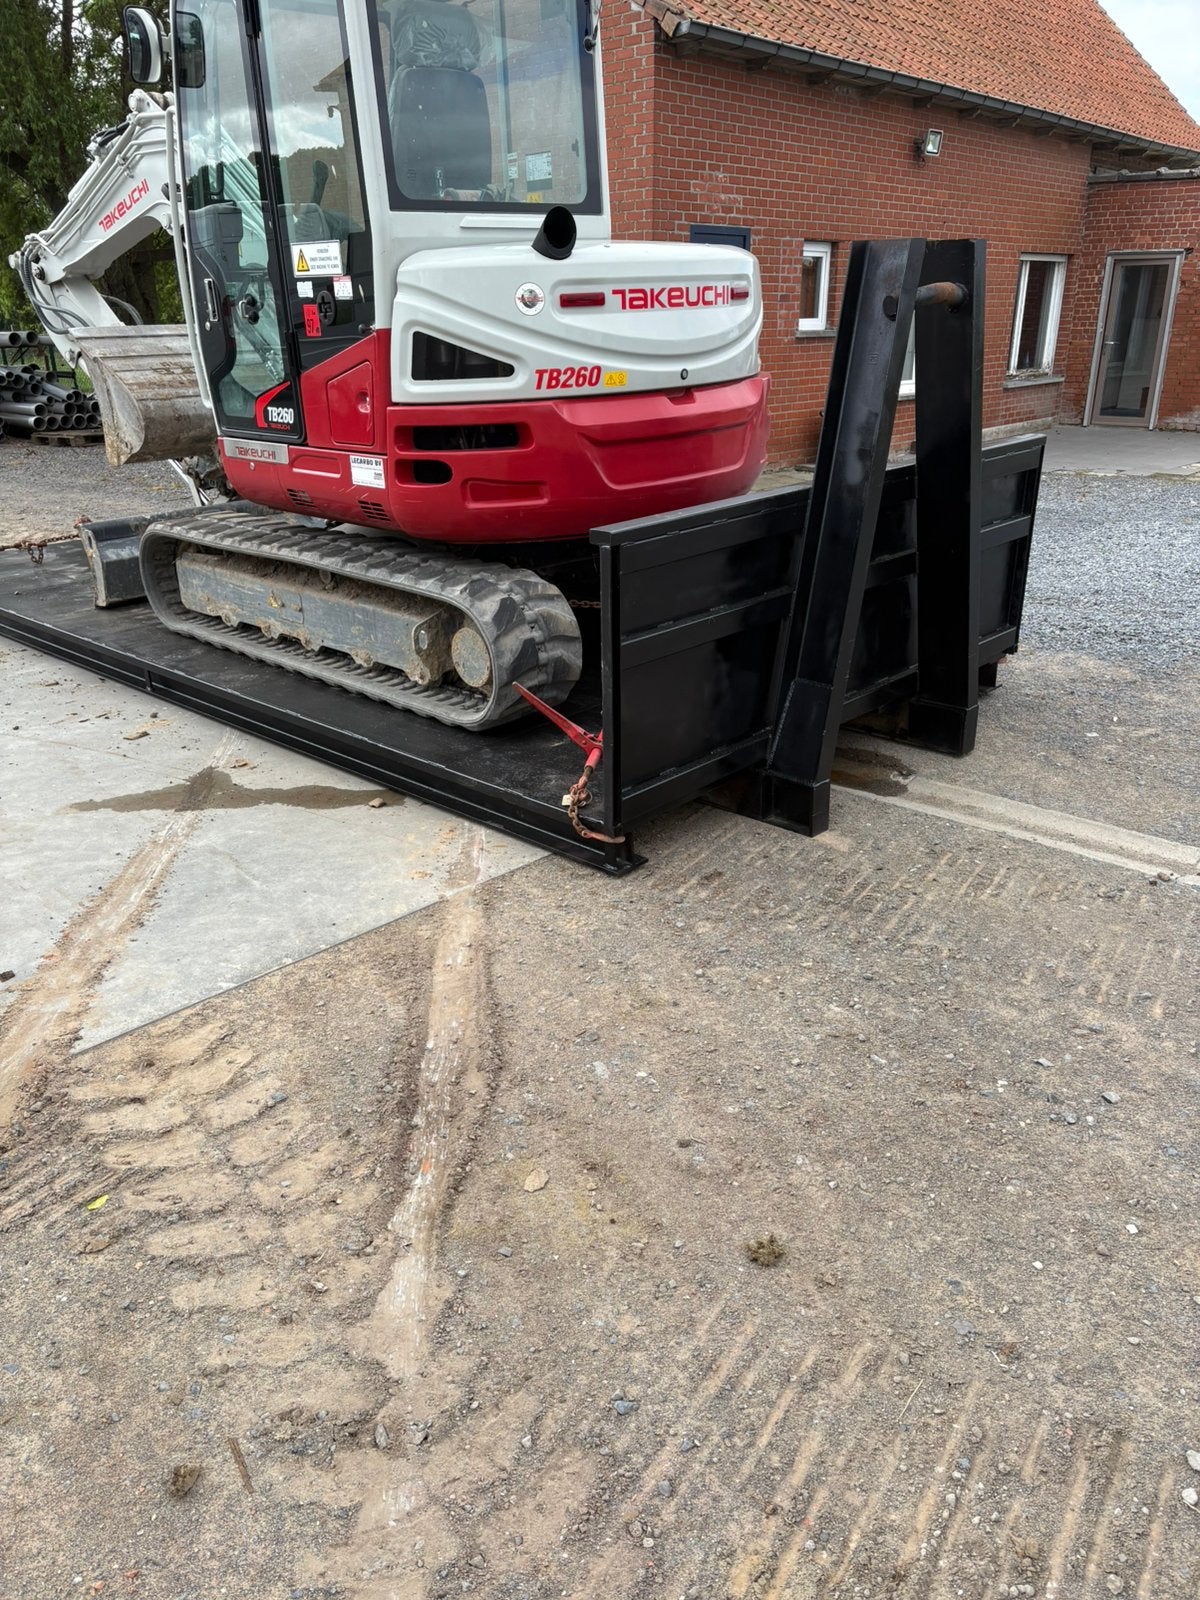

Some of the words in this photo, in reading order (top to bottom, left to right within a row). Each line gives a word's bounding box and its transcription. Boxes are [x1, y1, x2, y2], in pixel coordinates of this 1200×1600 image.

[98, 178, 150, 232] TAKEUCHI
[611, 285, 729, 310] TAKEUCHI
[306, 318, 314, 334] 97
[534, 365, 602, 390] TB260
[267, 406, 294, 424] TB260
[234, 445, 277, 460] TAKEUCHI
